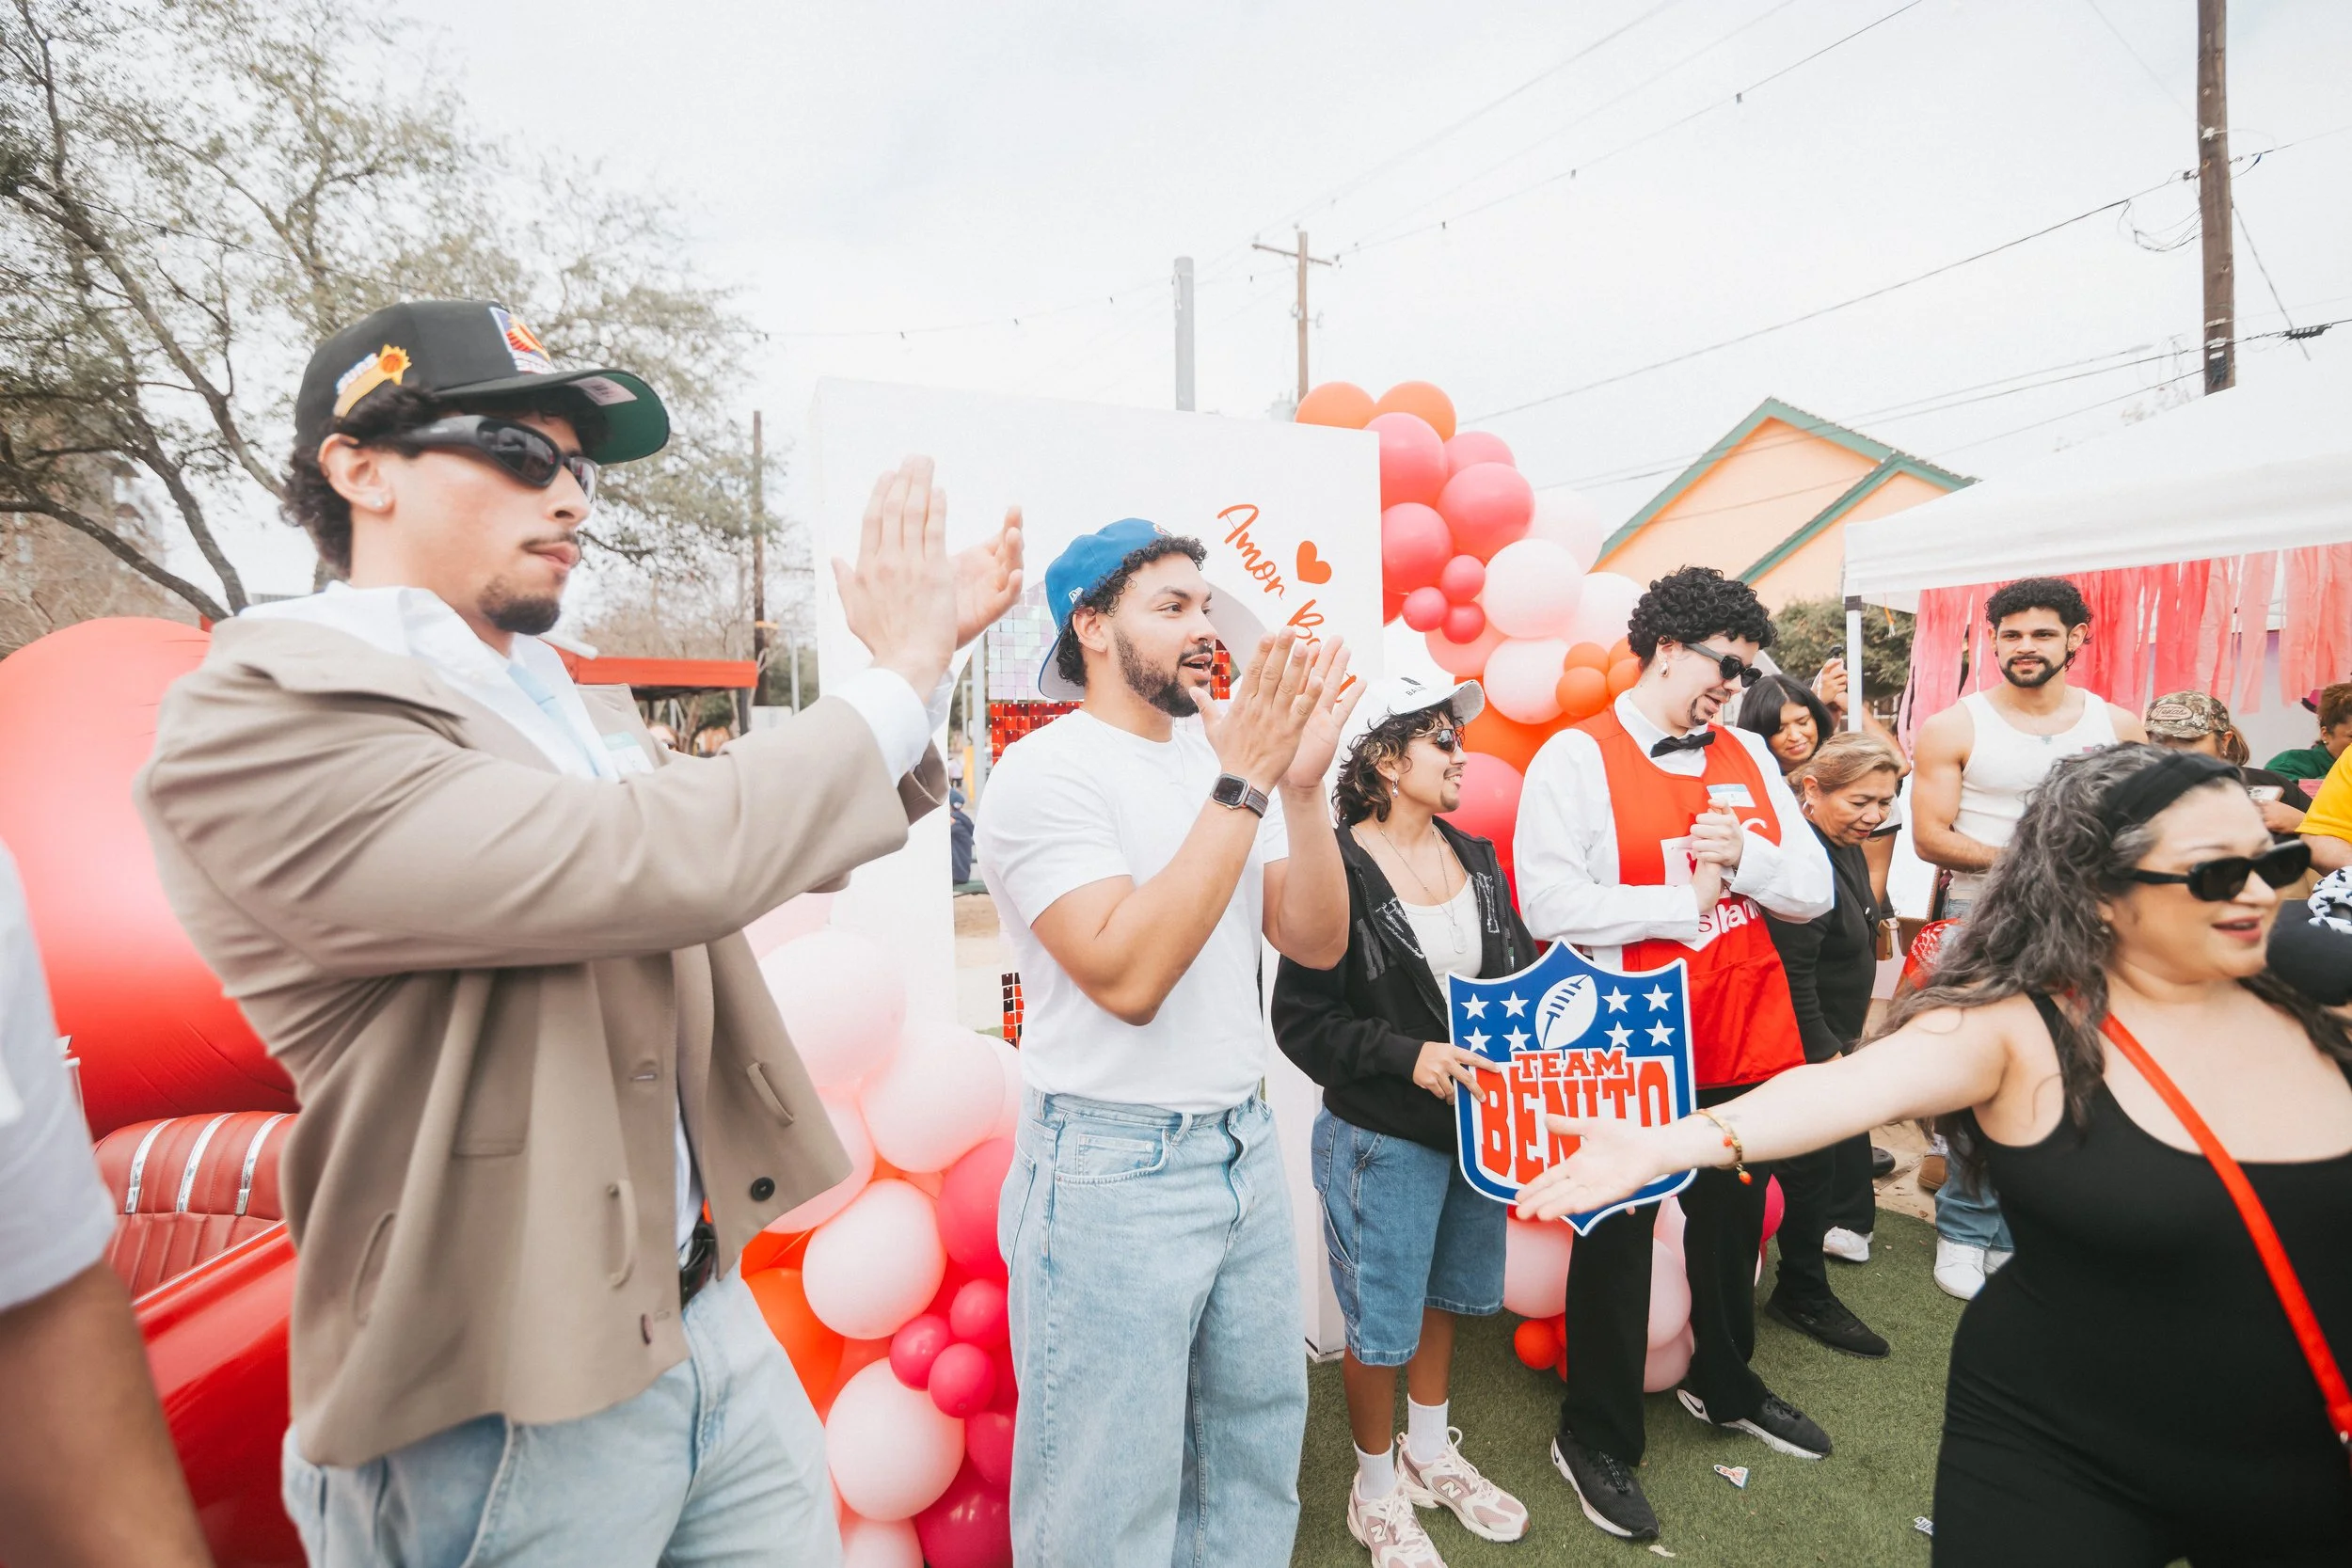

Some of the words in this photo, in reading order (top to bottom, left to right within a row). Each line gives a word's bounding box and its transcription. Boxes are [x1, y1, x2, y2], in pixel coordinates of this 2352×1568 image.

[1513, 1050, 1625, 1079] TEAM
[1441, 1481, 1462, 1498] N
[1371, 1524, 1387, 1543] N
